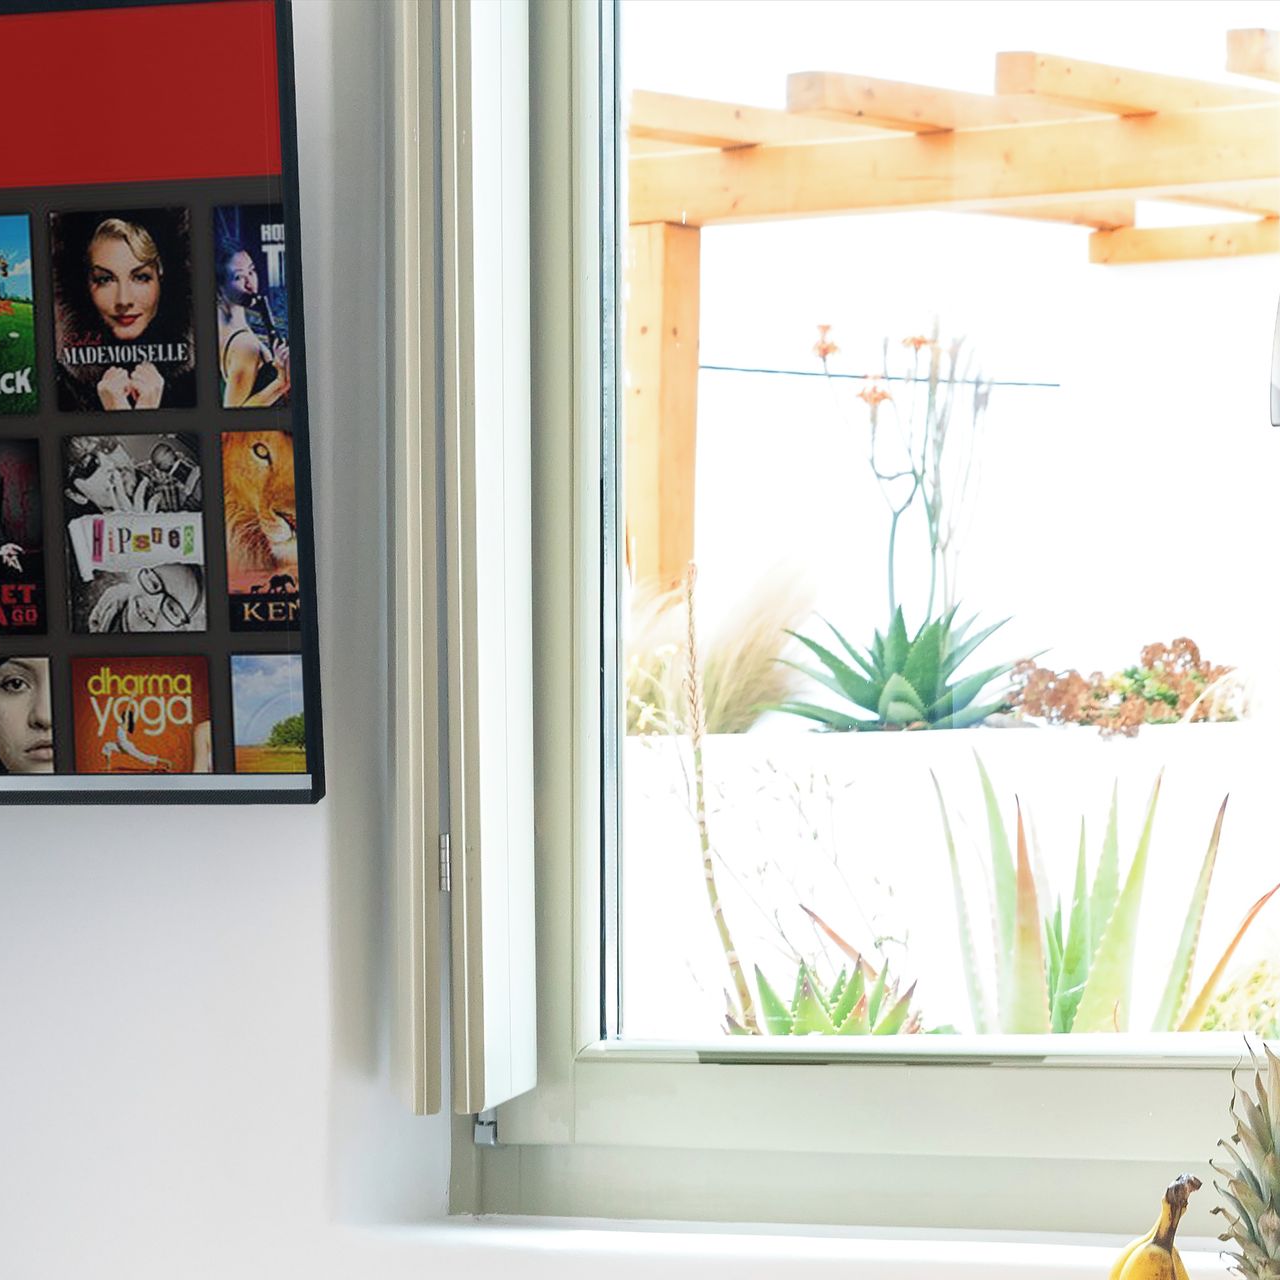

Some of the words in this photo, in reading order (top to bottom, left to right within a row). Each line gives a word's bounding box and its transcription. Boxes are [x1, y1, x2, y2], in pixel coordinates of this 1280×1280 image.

[63, 343, 188, 365] MADEMOISELLE
[87, 667, 192, 695] dharma
[90, 695, 193, 738] yoga
